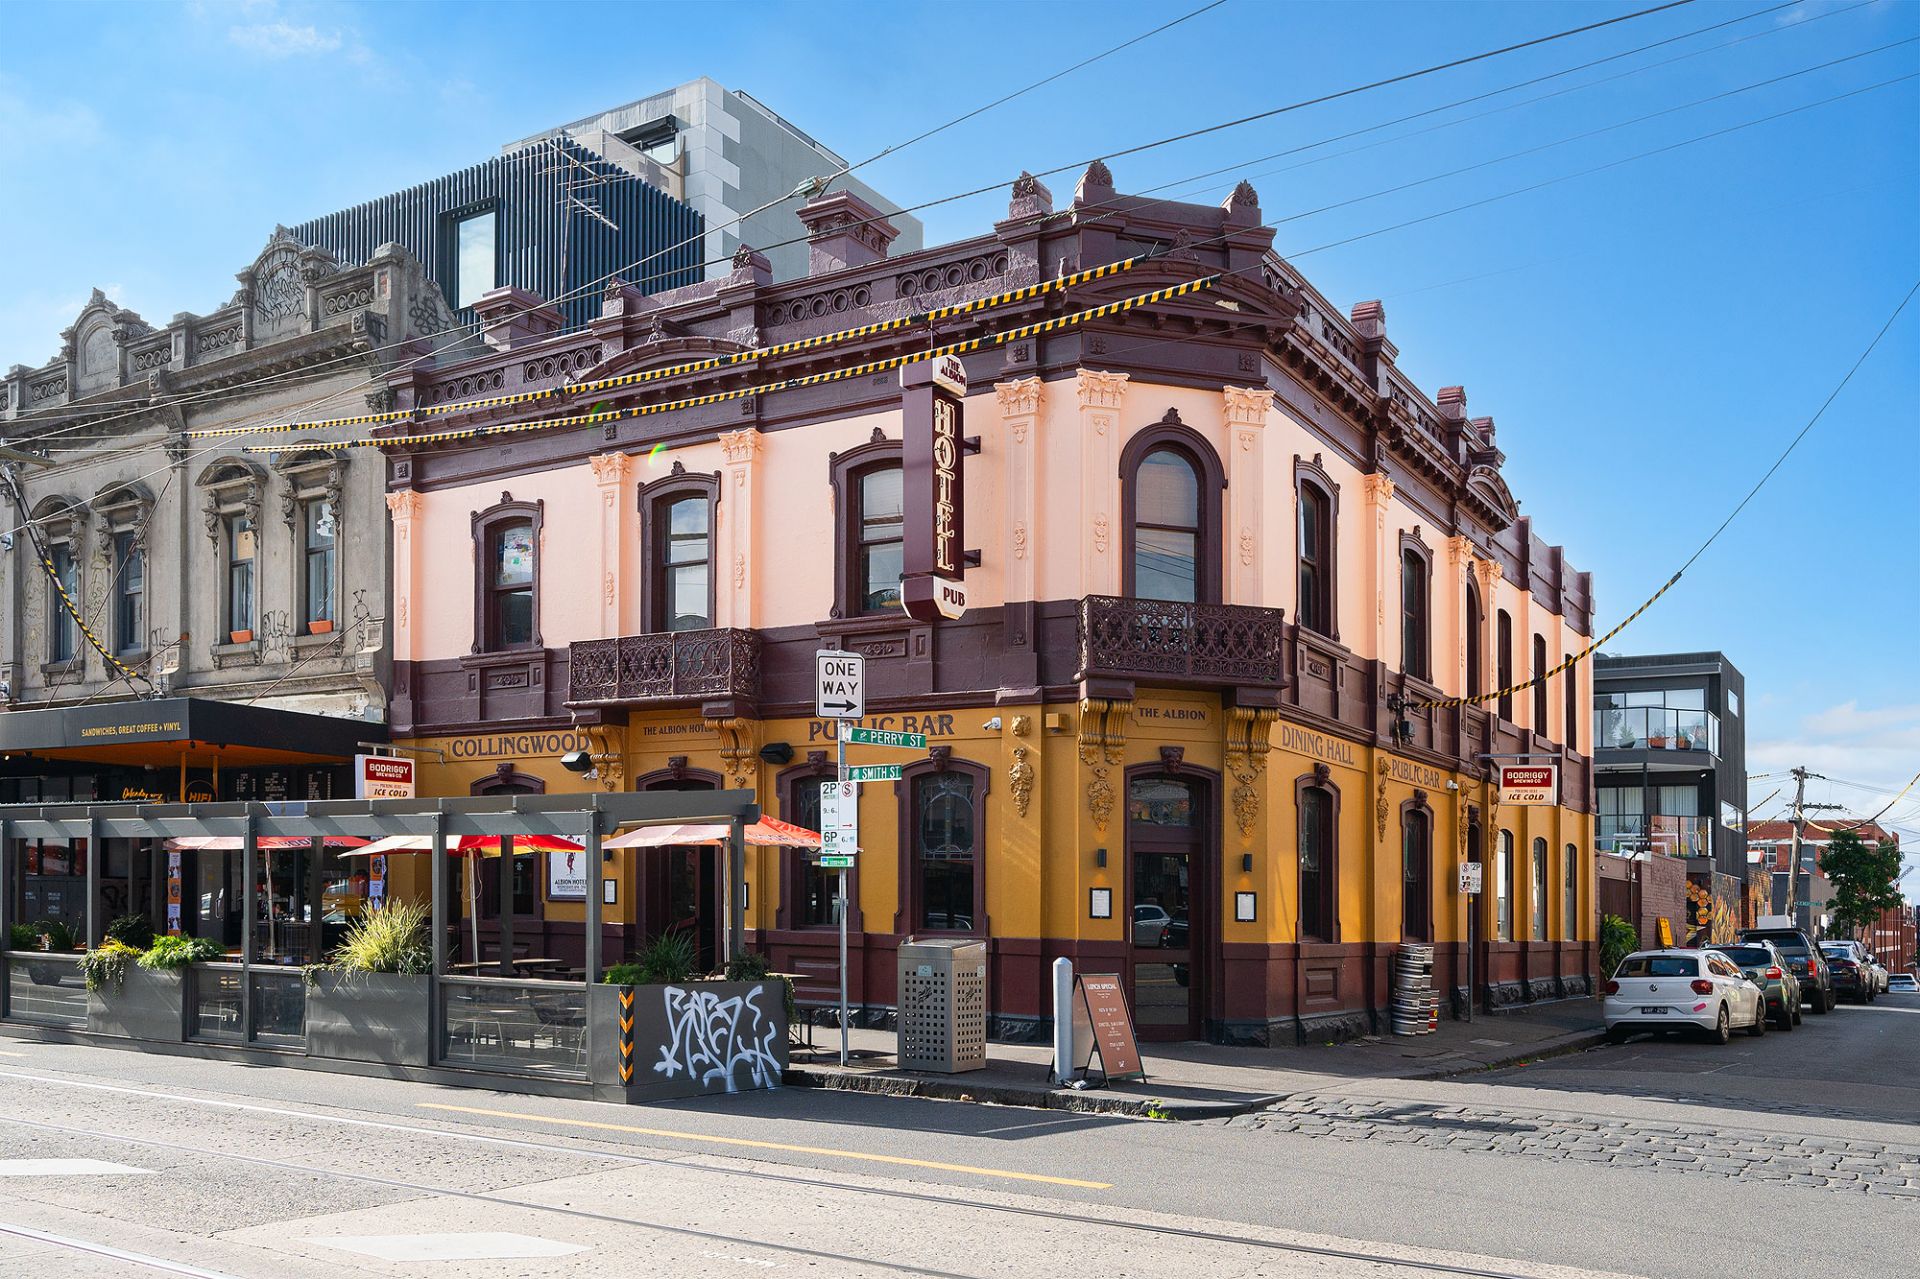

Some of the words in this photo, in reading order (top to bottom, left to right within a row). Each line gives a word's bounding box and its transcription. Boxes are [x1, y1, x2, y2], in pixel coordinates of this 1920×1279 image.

[947, 357, 960, 373] THE
[940, 365, 966, 387] ALBION
[934, 398, 956, 572] HOTEL
[943, 586, 966, 607] PUB
[824, 661, 857, 677] ONE
[822, 680, 859, 696] WAY
[1138, 707, 1160, 718] THE
[1163, 708, 1206, 721] ALBION
[81, 726, 118, 737] SANDWICHES,
[118, 725, 136, 735] GREAT
[136, 723, 159, 733] COFFEE
[163, 721, 182, 731] VINYL
[643, 726, 658, 736] THE
[658, 723, 687, 735] ALBION
[689, 723, 714, 734] HOT
[809, 717, 895, 741] PUIC
[902, 714, 955, 737] BAR
[452, 733, 590, 758] COLLINGWOOD
[870, 731, 904, 745] PERRY
[909, 736, 923, 748] ST
[1281, 725, 1324, 758] DINING
[1327, 738, 1355, 766] HALL
[369, 763, 409, 774] BODRIGGY
[862, 768, 887, 780] SMITH
[889, 765, 901, 776] ST
[1391, 758, 1422, 785] PUBLIC
[1424, 768, 1441, 789] BAR
[1506, 771, 1549, 779] BODRIGGY
[374, 788, 387, 797] ICE
[388, 790, 408, 798] COLD
[822, 783, 837, 795] 2P
[1508, 793, 1521, 801] ICE
[1523, 793, 1545, 801] COLD
[823, 831, 838, 843] 6P
